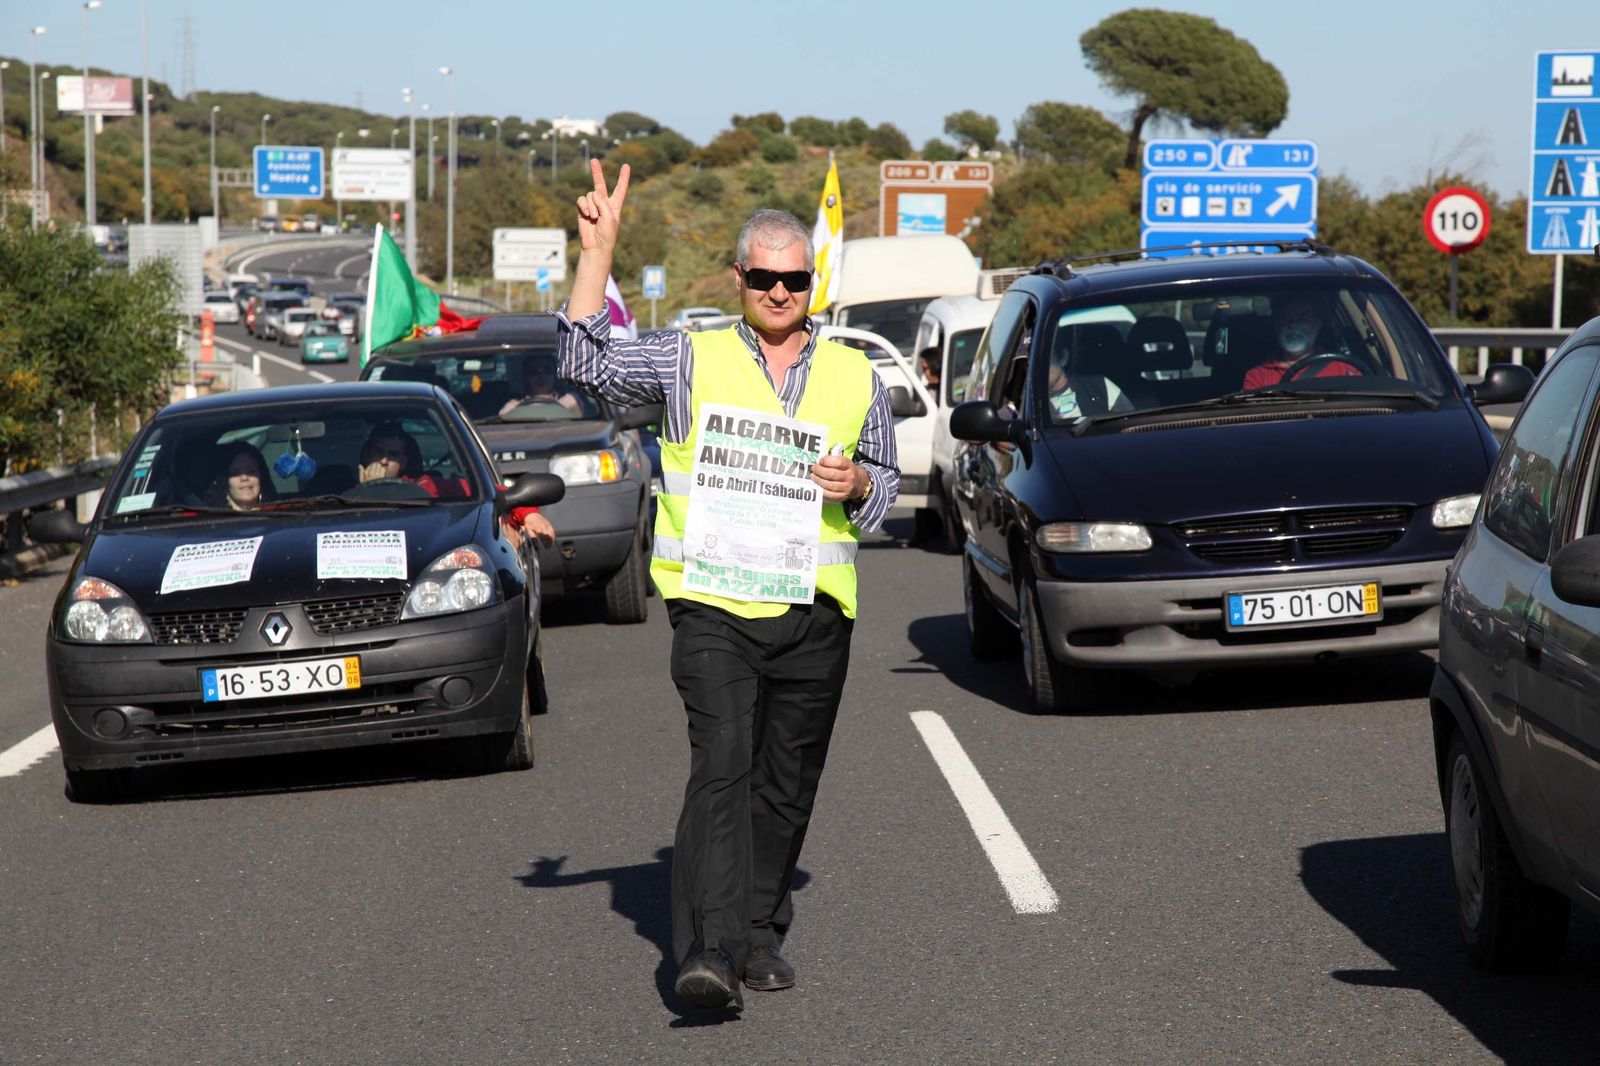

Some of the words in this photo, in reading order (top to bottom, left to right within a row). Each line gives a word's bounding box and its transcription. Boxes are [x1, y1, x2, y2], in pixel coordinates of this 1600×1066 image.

[1153, 149, 1187, 162] 250
[1193, 151, 1208, 162] m
[1284, 149, 1309, 162] 131
[1183, 182, 1200, 194] de
[1206, 181, 1263, 195] servicio
[1438, 211, 1479, 231] 110
[705, 413, 821, 453] ALGARVE
[697, 473, 705, 486] 9
[708, 474, 724, 489] de
[726, 477, 757, 493] Abril
[696, 559, 801, 586] Portagens
[714, 578, 754, 597] A22
[1367, 602, 1377, 611] 11
[1233, 612, 1241, 621] P
[345, 661, 358, 670] 04
[208, 689, 215, 697] P
